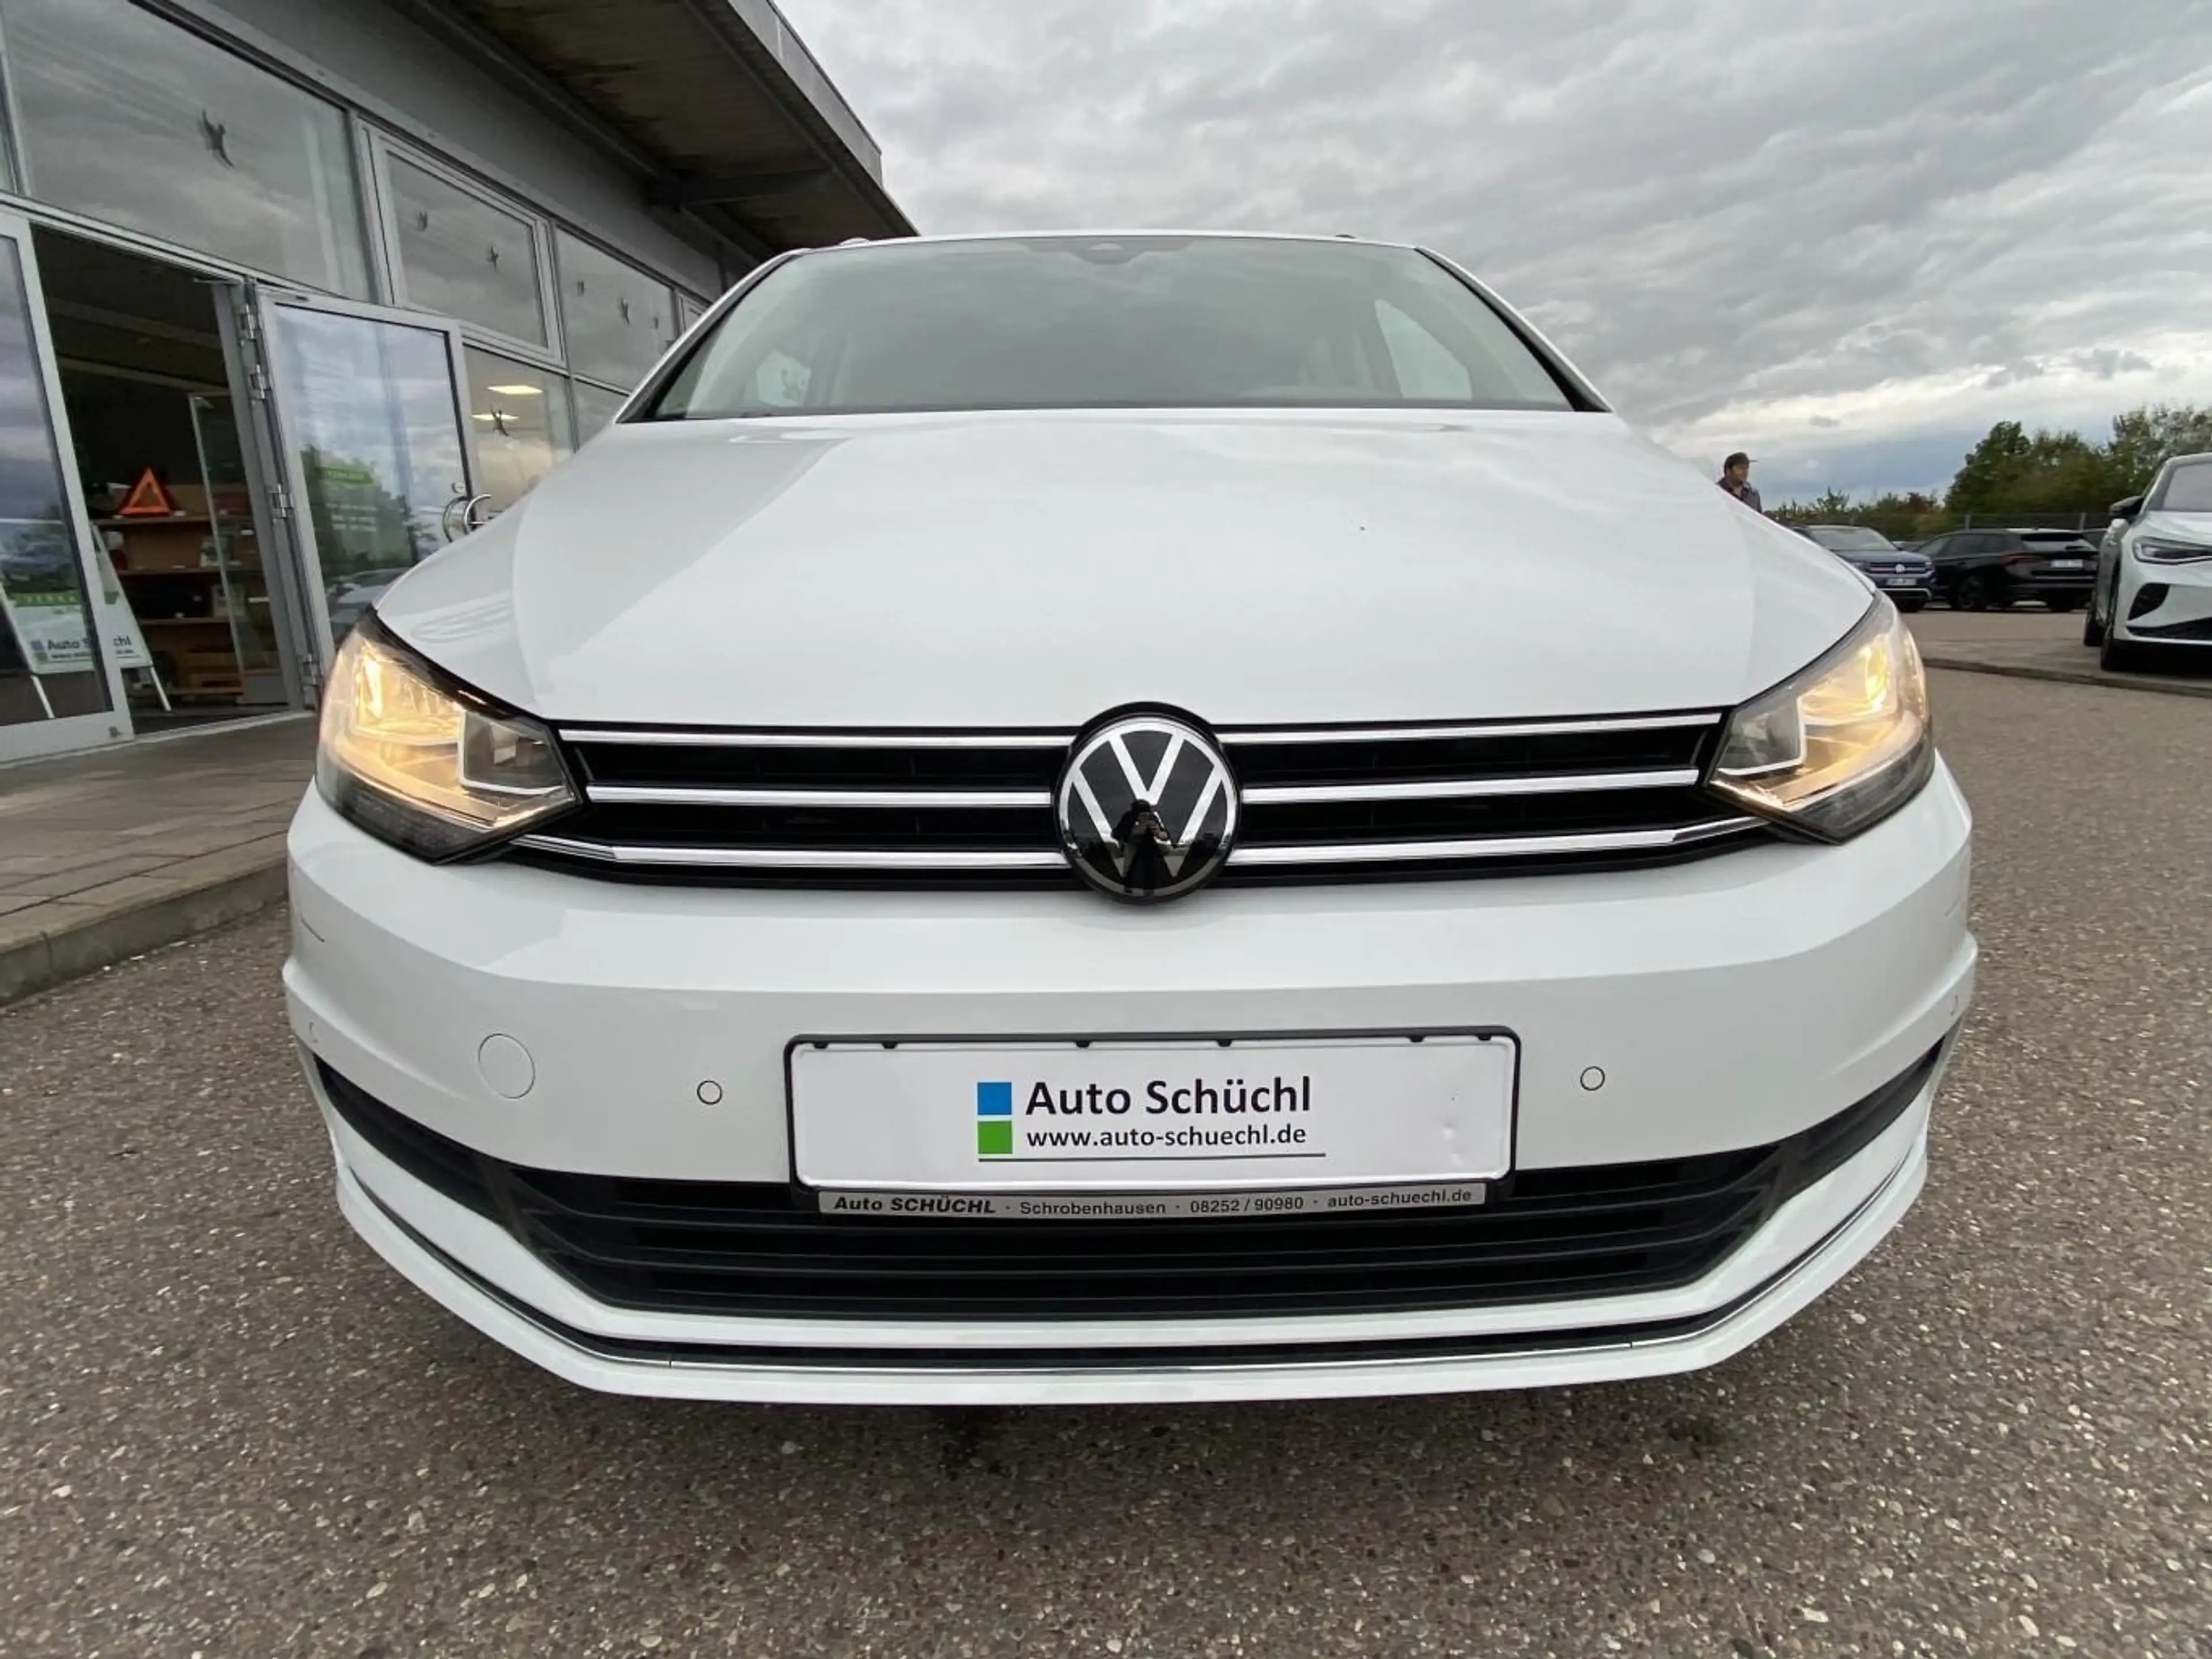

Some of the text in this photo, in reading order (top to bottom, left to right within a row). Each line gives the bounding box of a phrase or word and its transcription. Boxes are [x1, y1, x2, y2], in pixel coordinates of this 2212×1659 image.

[1026, 1076, 1310, 1115] Auto Schüchl
[1027, 1123, 1306, 1147] www.auto-schuechl.de
[834, 1196, 883, 1211] Auto
[890, 1195, 996, 1214] SCHÜCHL
[1019, 1200, 1166, 1215] Schrobenhausen
[1327, 1190, 1472, 1207] auto-schuechl.de
